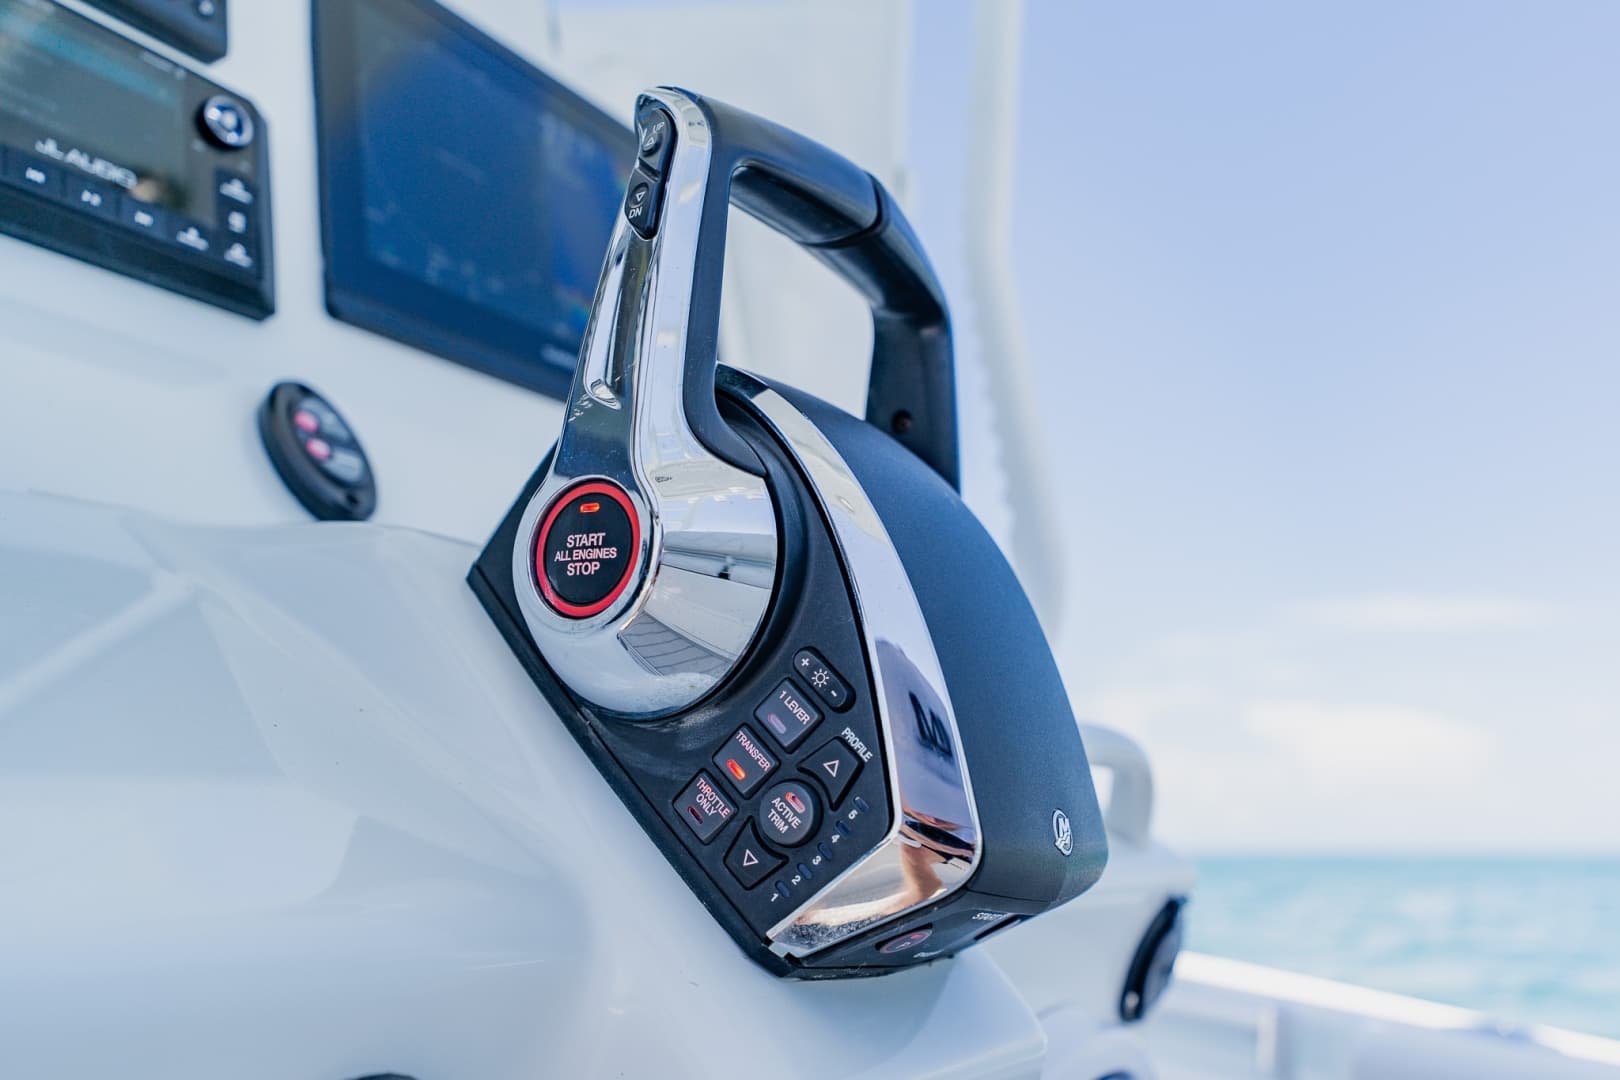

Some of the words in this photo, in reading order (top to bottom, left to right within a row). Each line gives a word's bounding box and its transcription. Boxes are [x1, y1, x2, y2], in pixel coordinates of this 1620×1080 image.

[652, 121, 665, 134] UP
[628, 207, 643, 219] DN
[566, 532, 606, 548] START
[554, 550, 572, 562] ALL
[572, 547, 618, 560] ENGINES
[566, 561, 600, 576] STOP
[778, 690, 787, 699] 1
[783, 696, 811, 725] LEVER
[735, 731, 771, 772] TRANSFER
[841, 727, 873, 763] PROFILE
[695, 794, 718, 817] ONLY
[696, 777, 731, 819] THROTTLE
[771, 797, 801, 829] ACTIVE
[767, 808, 789, 835] TRIM
[831, 834, 841, 844] 4
[812, 855, 822, 866] 3
[791, 874, 802, 886] 2
[770, 892, 779, 902] 1
